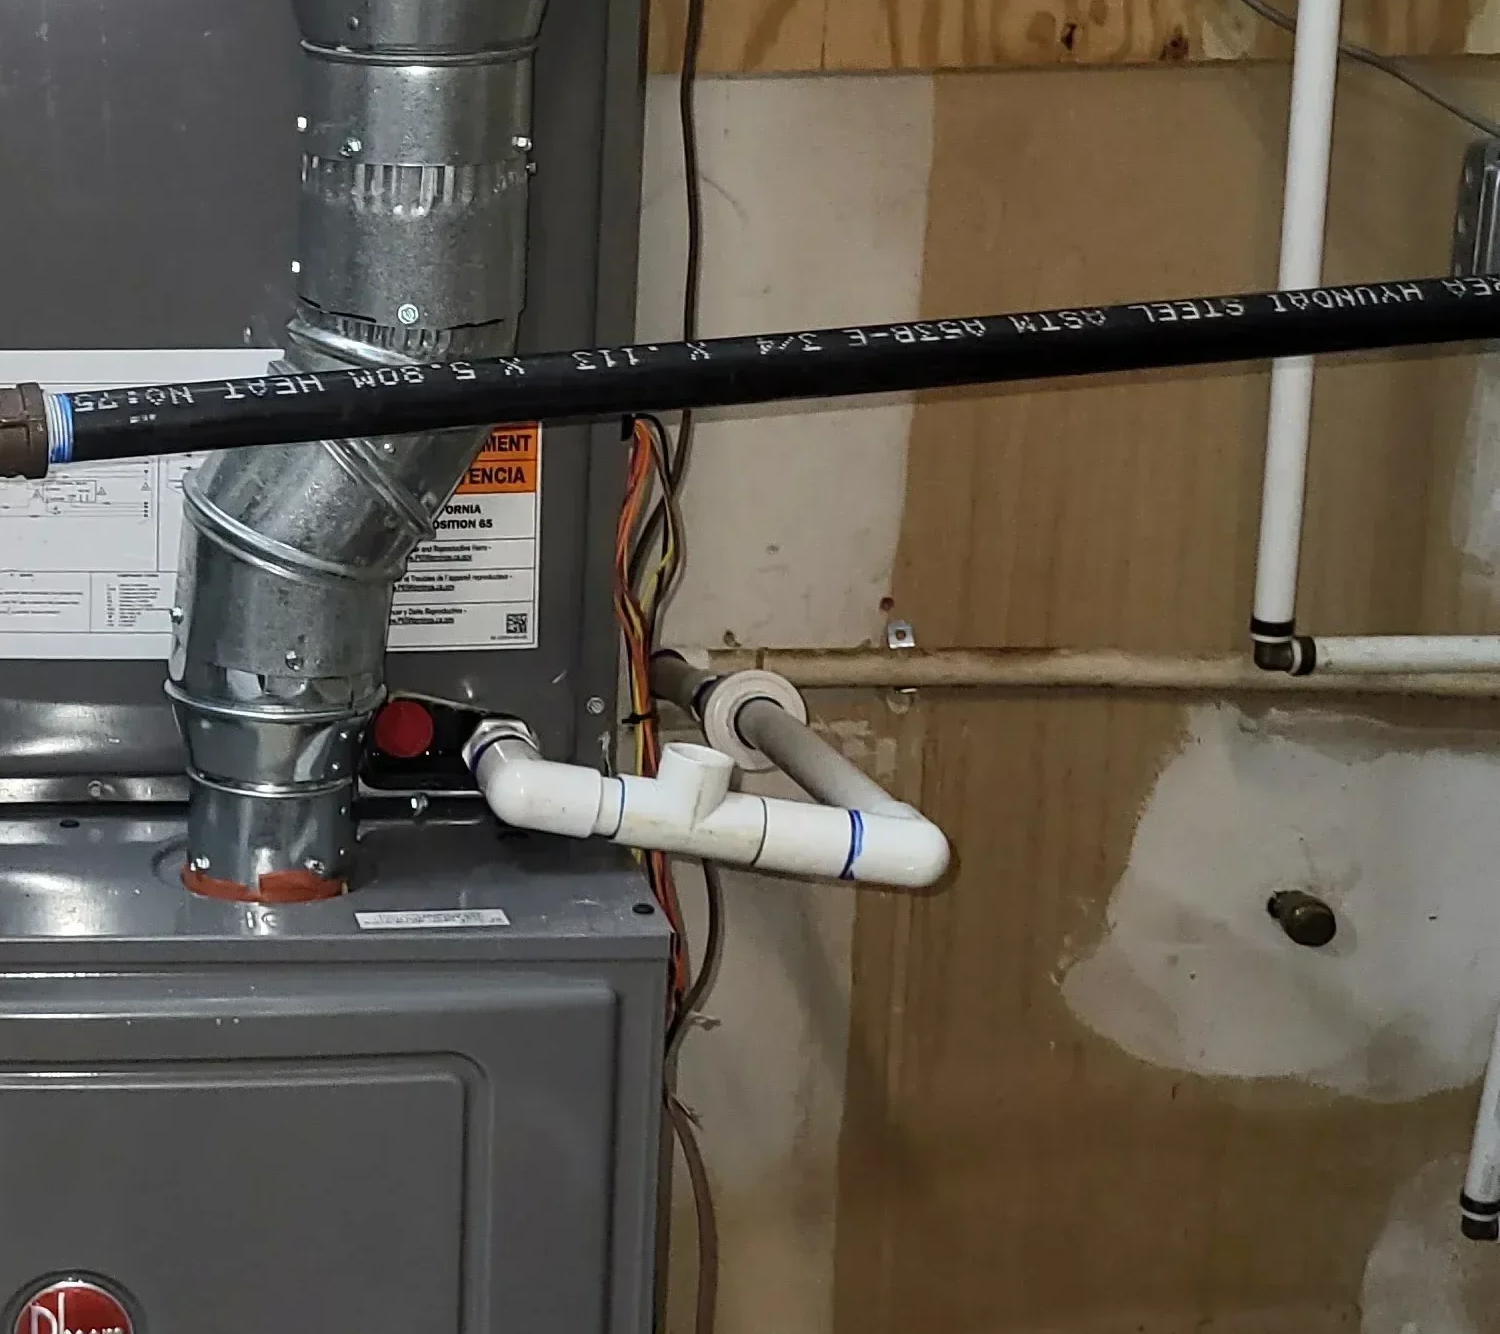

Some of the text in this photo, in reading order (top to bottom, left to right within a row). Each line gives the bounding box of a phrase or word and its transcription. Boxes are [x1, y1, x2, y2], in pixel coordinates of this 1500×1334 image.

[1128, 296, 1245, 323] STEEL
[1273, 281, 1423, 314] HYUNDAI
[848, 318, 986, 347] A53B-E
[1009, 308, 1106, 332] ASTM
[573, 345, 659, 371] .113
[225, 373, 324, 400] HEAT
[482, 435, 532, 452] MENT
[461, 467, 526, 485] TENCIA
[442, 504, 481, 515] ORNIA
[433, 519, 493, 529] OSITION 65
